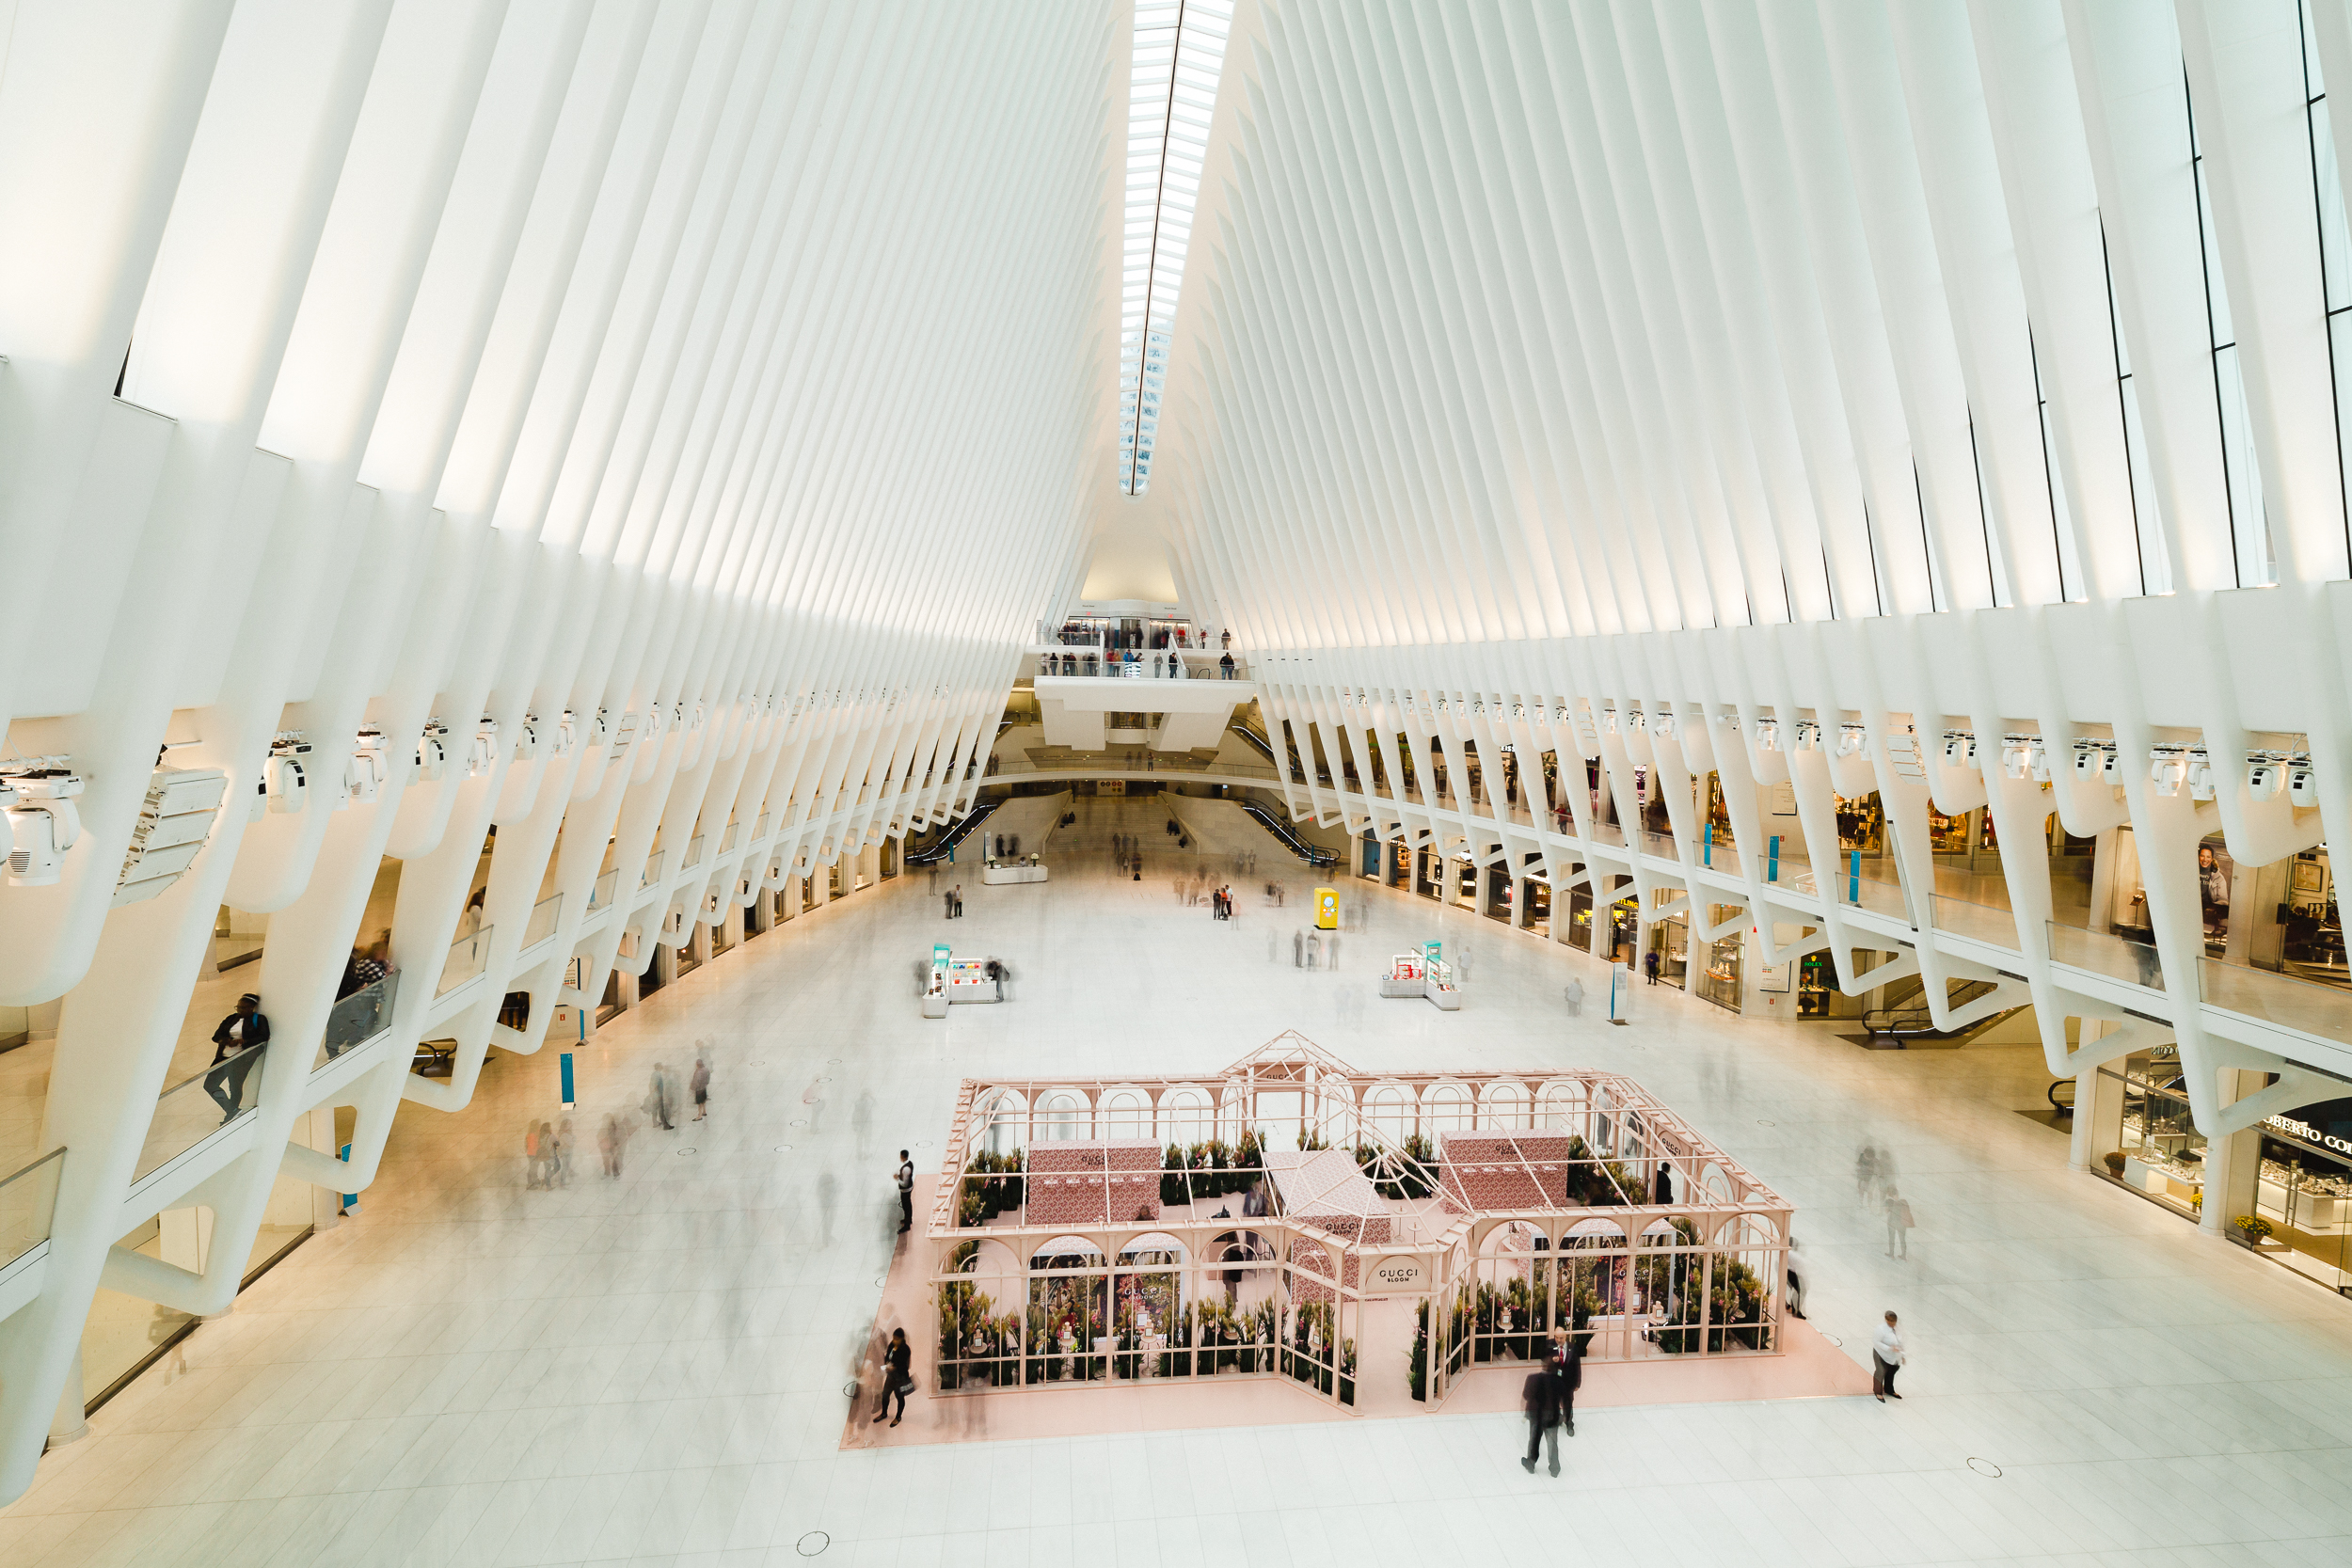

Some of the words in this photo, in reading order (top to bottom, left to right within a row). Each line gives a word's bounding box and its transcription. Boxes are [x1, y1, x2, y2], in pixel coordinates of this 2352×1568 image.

[1661, 1137, 1681, 1155] GUCCI
[1326, 1222, 1359, 1230] GUCCI
[1379, 1268, 1418, 1277] GUCCI
[1124, 1286, 1163, 1295] GUCCI
